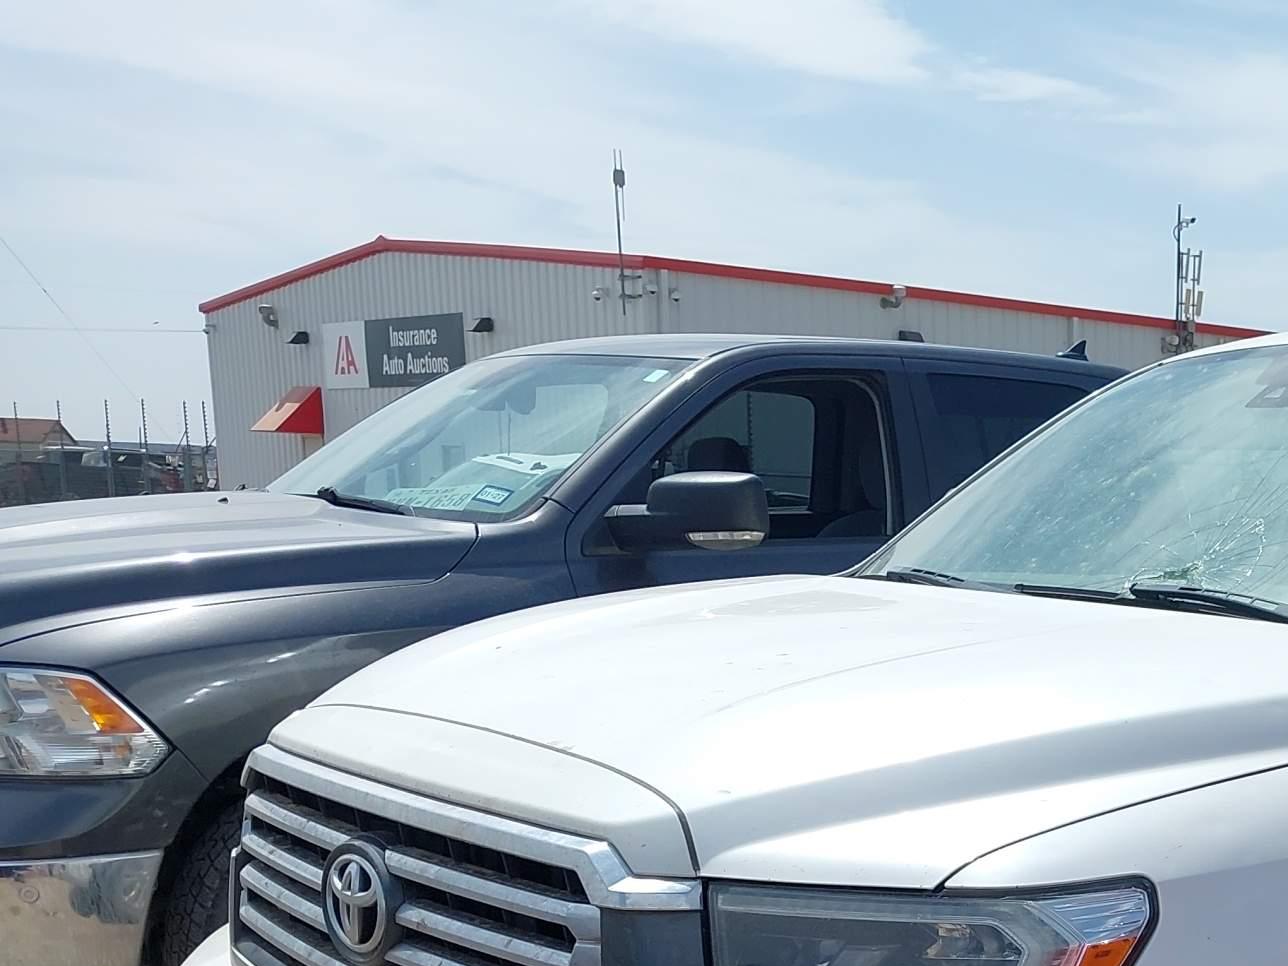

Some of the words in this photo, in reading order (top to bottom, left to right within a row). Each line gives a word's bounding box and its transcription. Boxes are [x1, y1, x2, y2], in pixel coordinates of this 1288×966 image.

[389, 326, 437, 348] Insurance
[382, 354, 405, 375] Auto
[407, 351, 449, 375] Auctions
